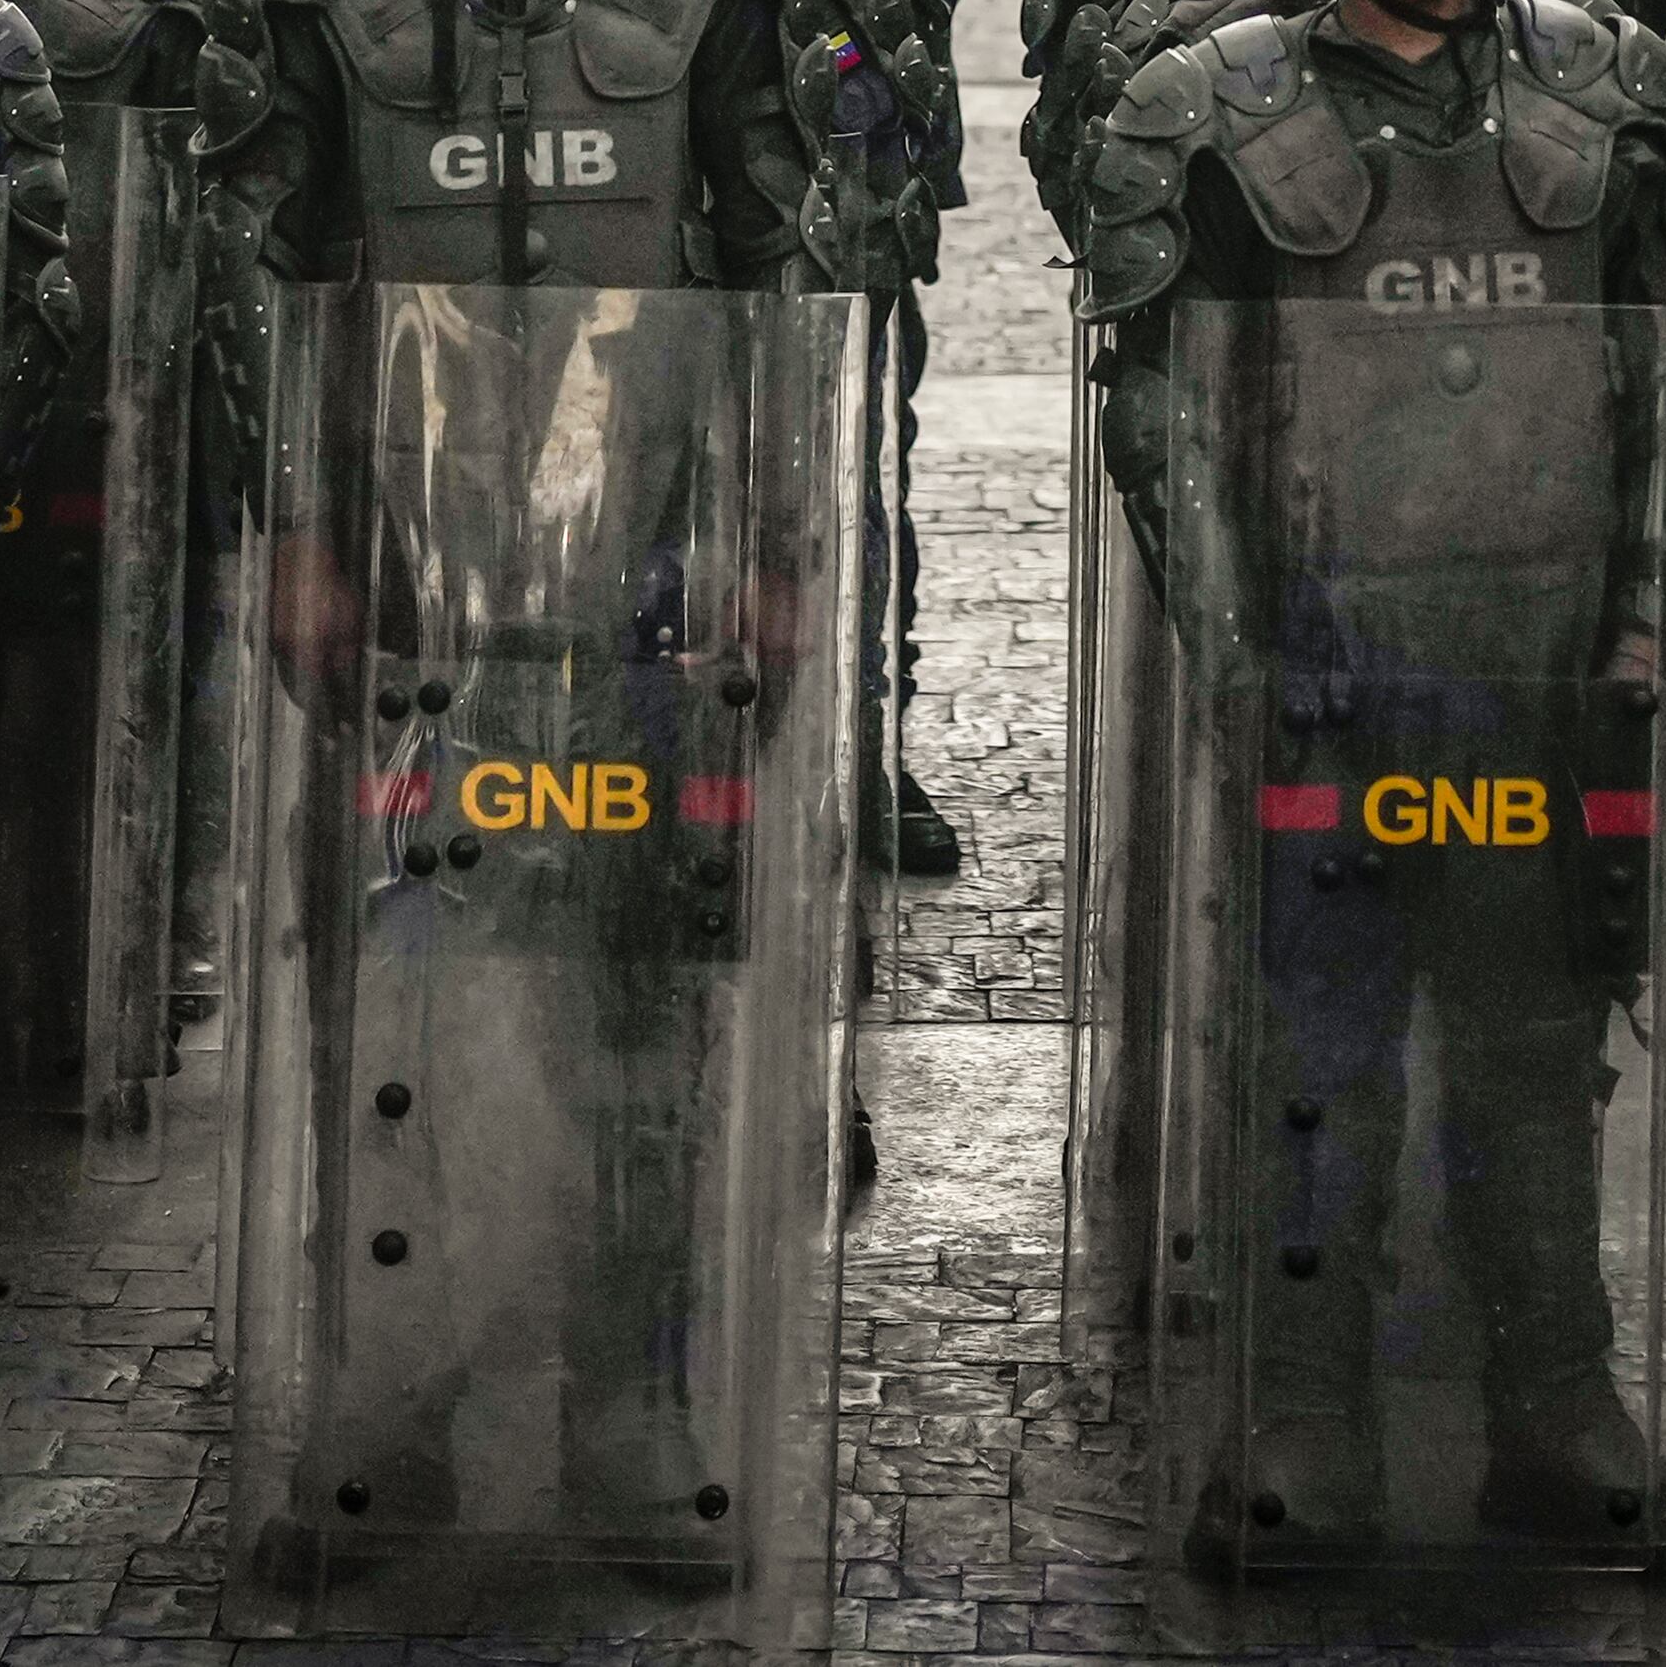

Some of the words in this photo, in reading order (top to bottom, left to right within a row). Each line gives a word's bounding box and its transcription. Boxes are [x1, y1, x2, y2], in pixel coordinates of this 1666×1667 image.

[430, 130, 617, 190] GNB
[1365, 252, 1547, 315] GNB
[461, 761, 651, 831] GNB
[1363, 775, 1551, 847] GNB
